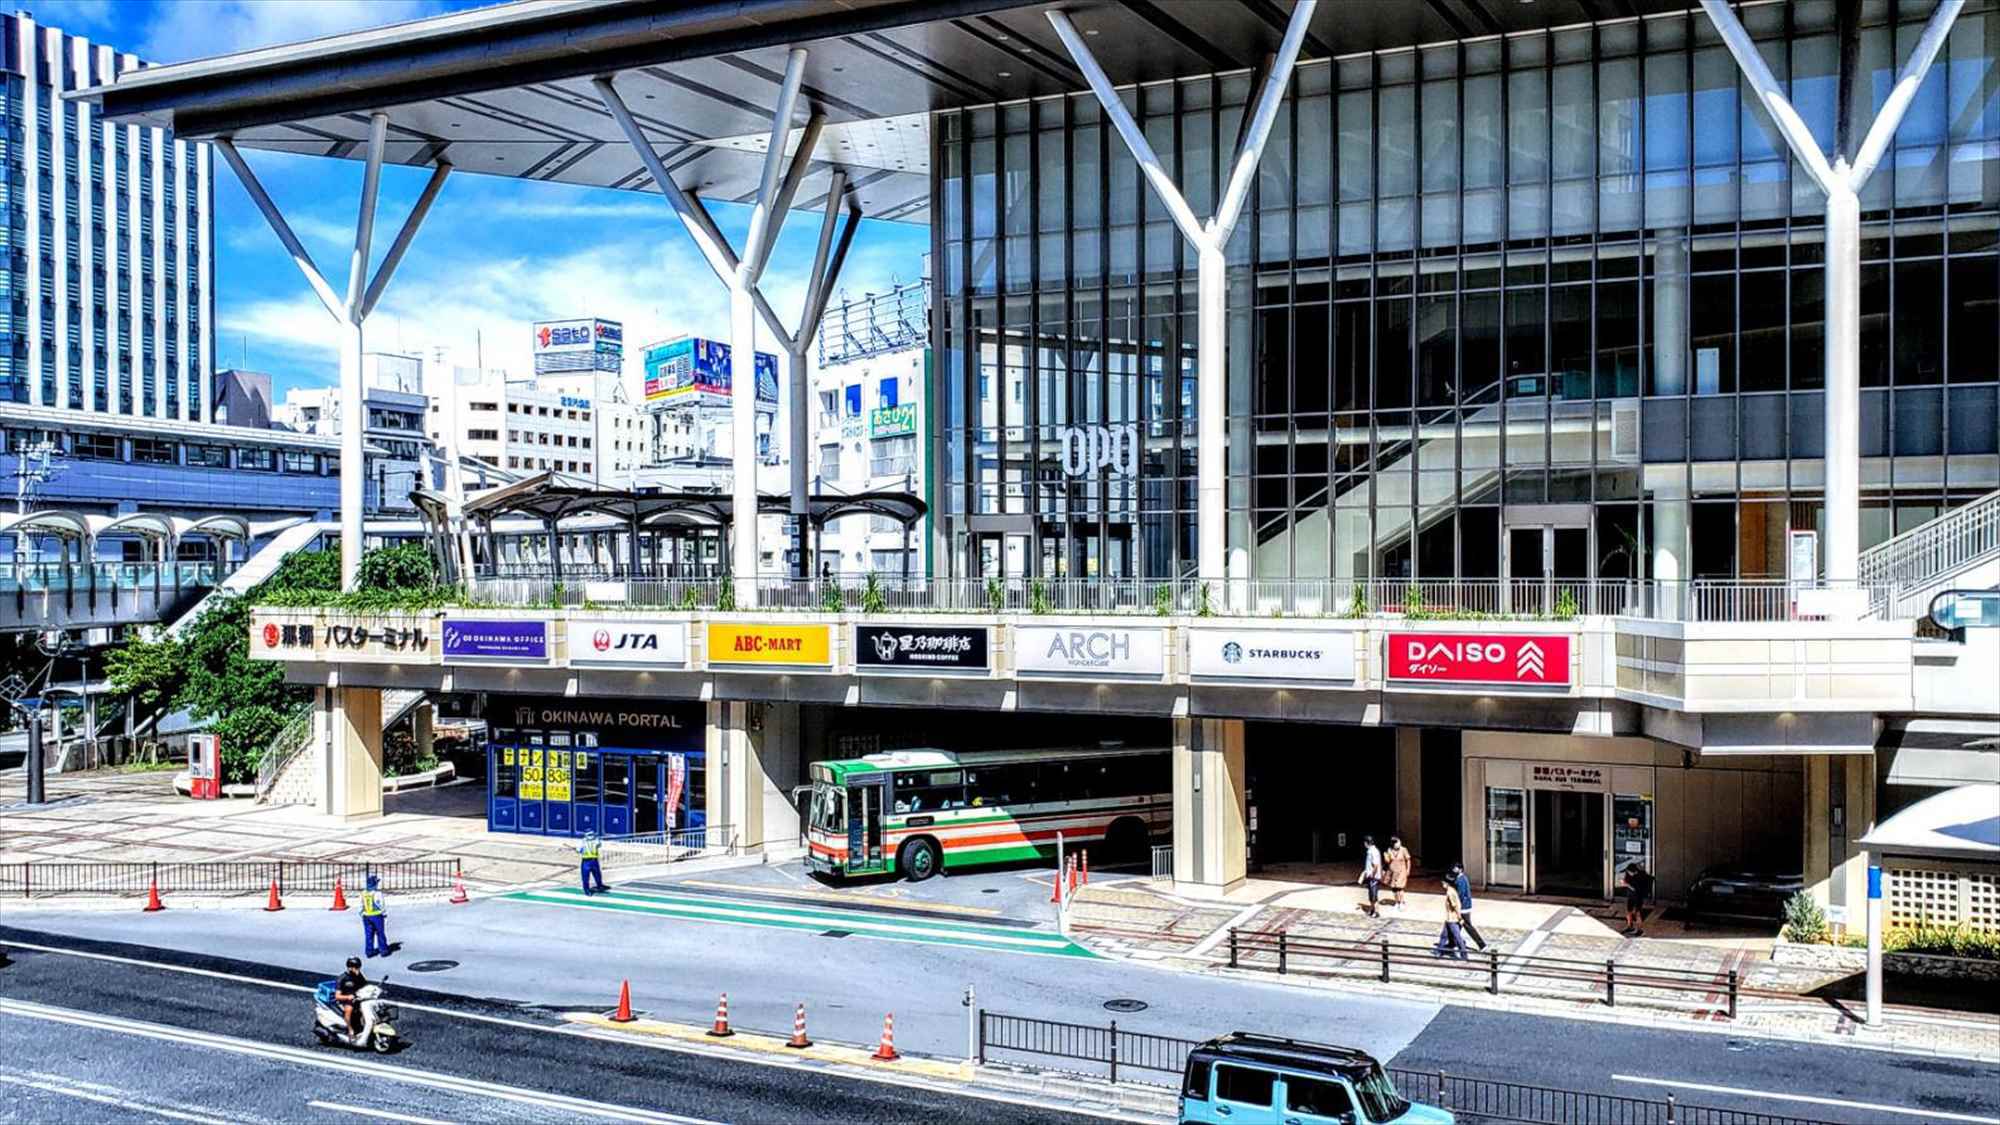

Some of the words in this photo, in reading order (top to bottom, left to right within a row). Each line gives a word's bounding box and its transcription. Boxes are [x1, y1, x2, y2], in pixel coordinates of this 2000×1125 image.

[324, 626, 428, 652] バスターミナル
[615, 633, 658, 650] JTA
[899, 634, 972, 653] 星乃珈琲店
[1046, 632, 1130, 661] ARCH
[1249, 648, 1321, 660] STARBUCKS
[1408, 641, 1506, 662] DAISO
[1408, 664, 1448, 674] ダイソー
[542, 710, 614, 726] OKINAWA
[618, 712, 682, 728] PORTAL
